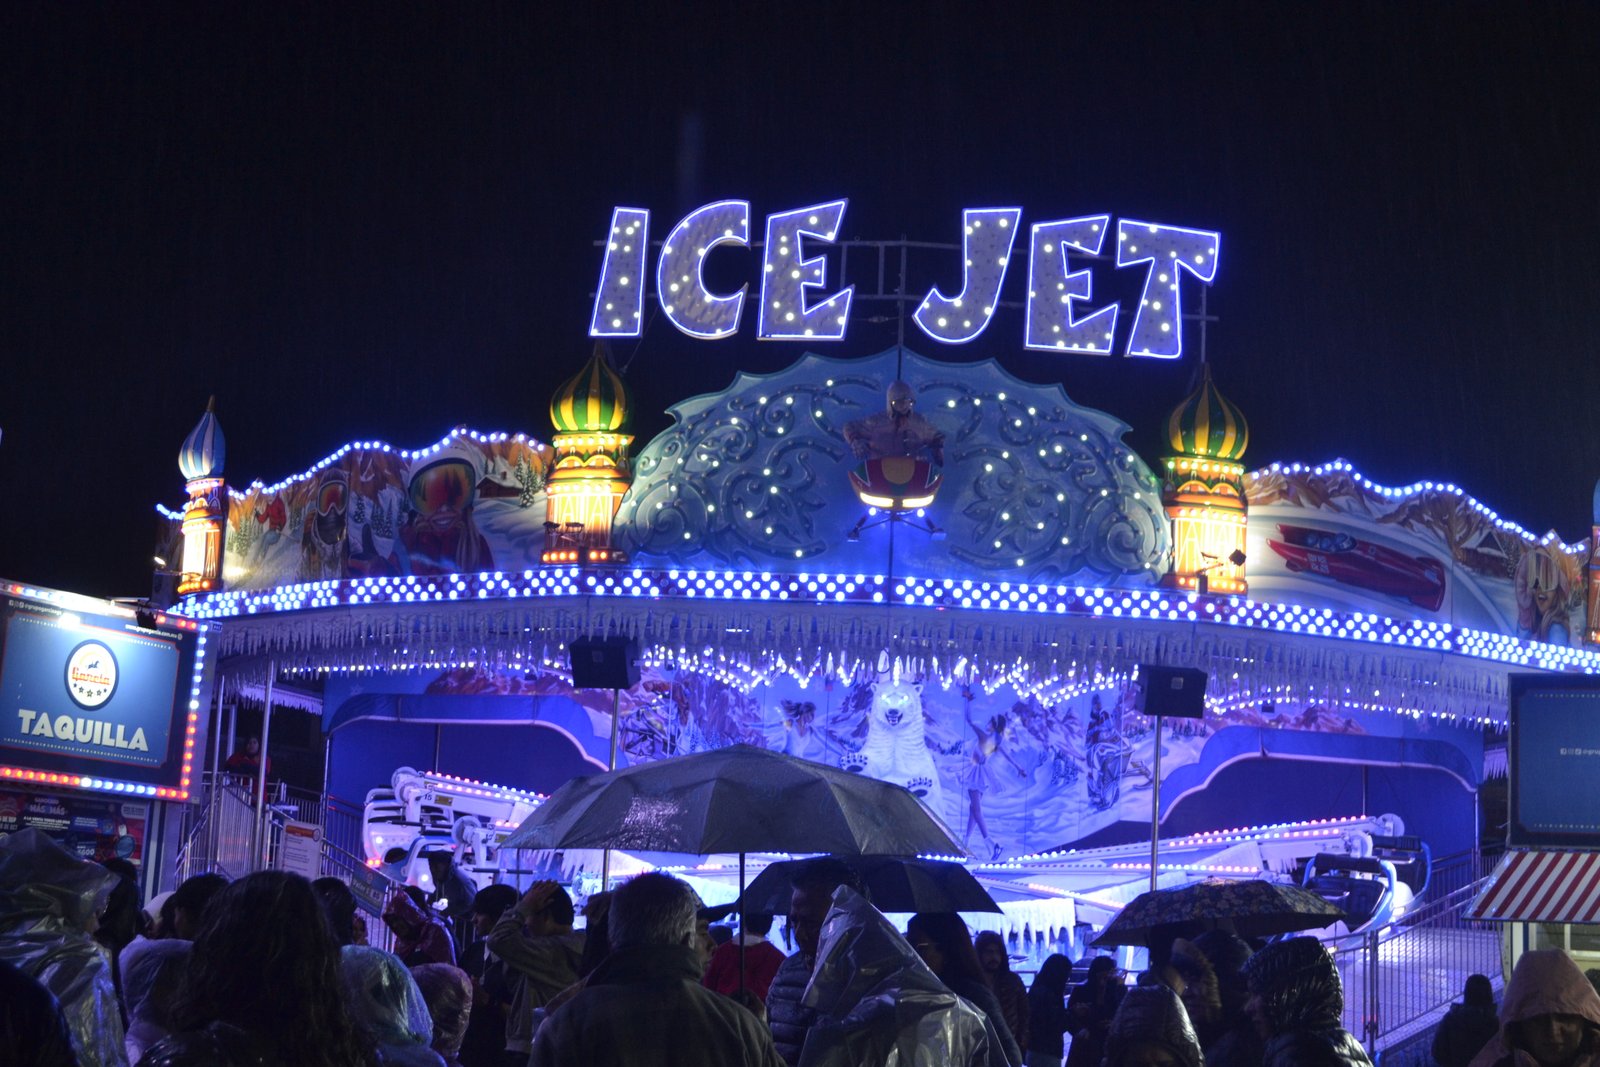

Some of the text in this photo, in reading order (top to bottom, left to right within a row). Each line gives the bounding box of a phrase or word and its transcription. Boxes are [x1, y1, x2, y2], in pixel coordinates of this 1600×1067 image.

[588, 198, 1221, 359] ICE JET
[18, 708, 149, 752] TAQUILLA
